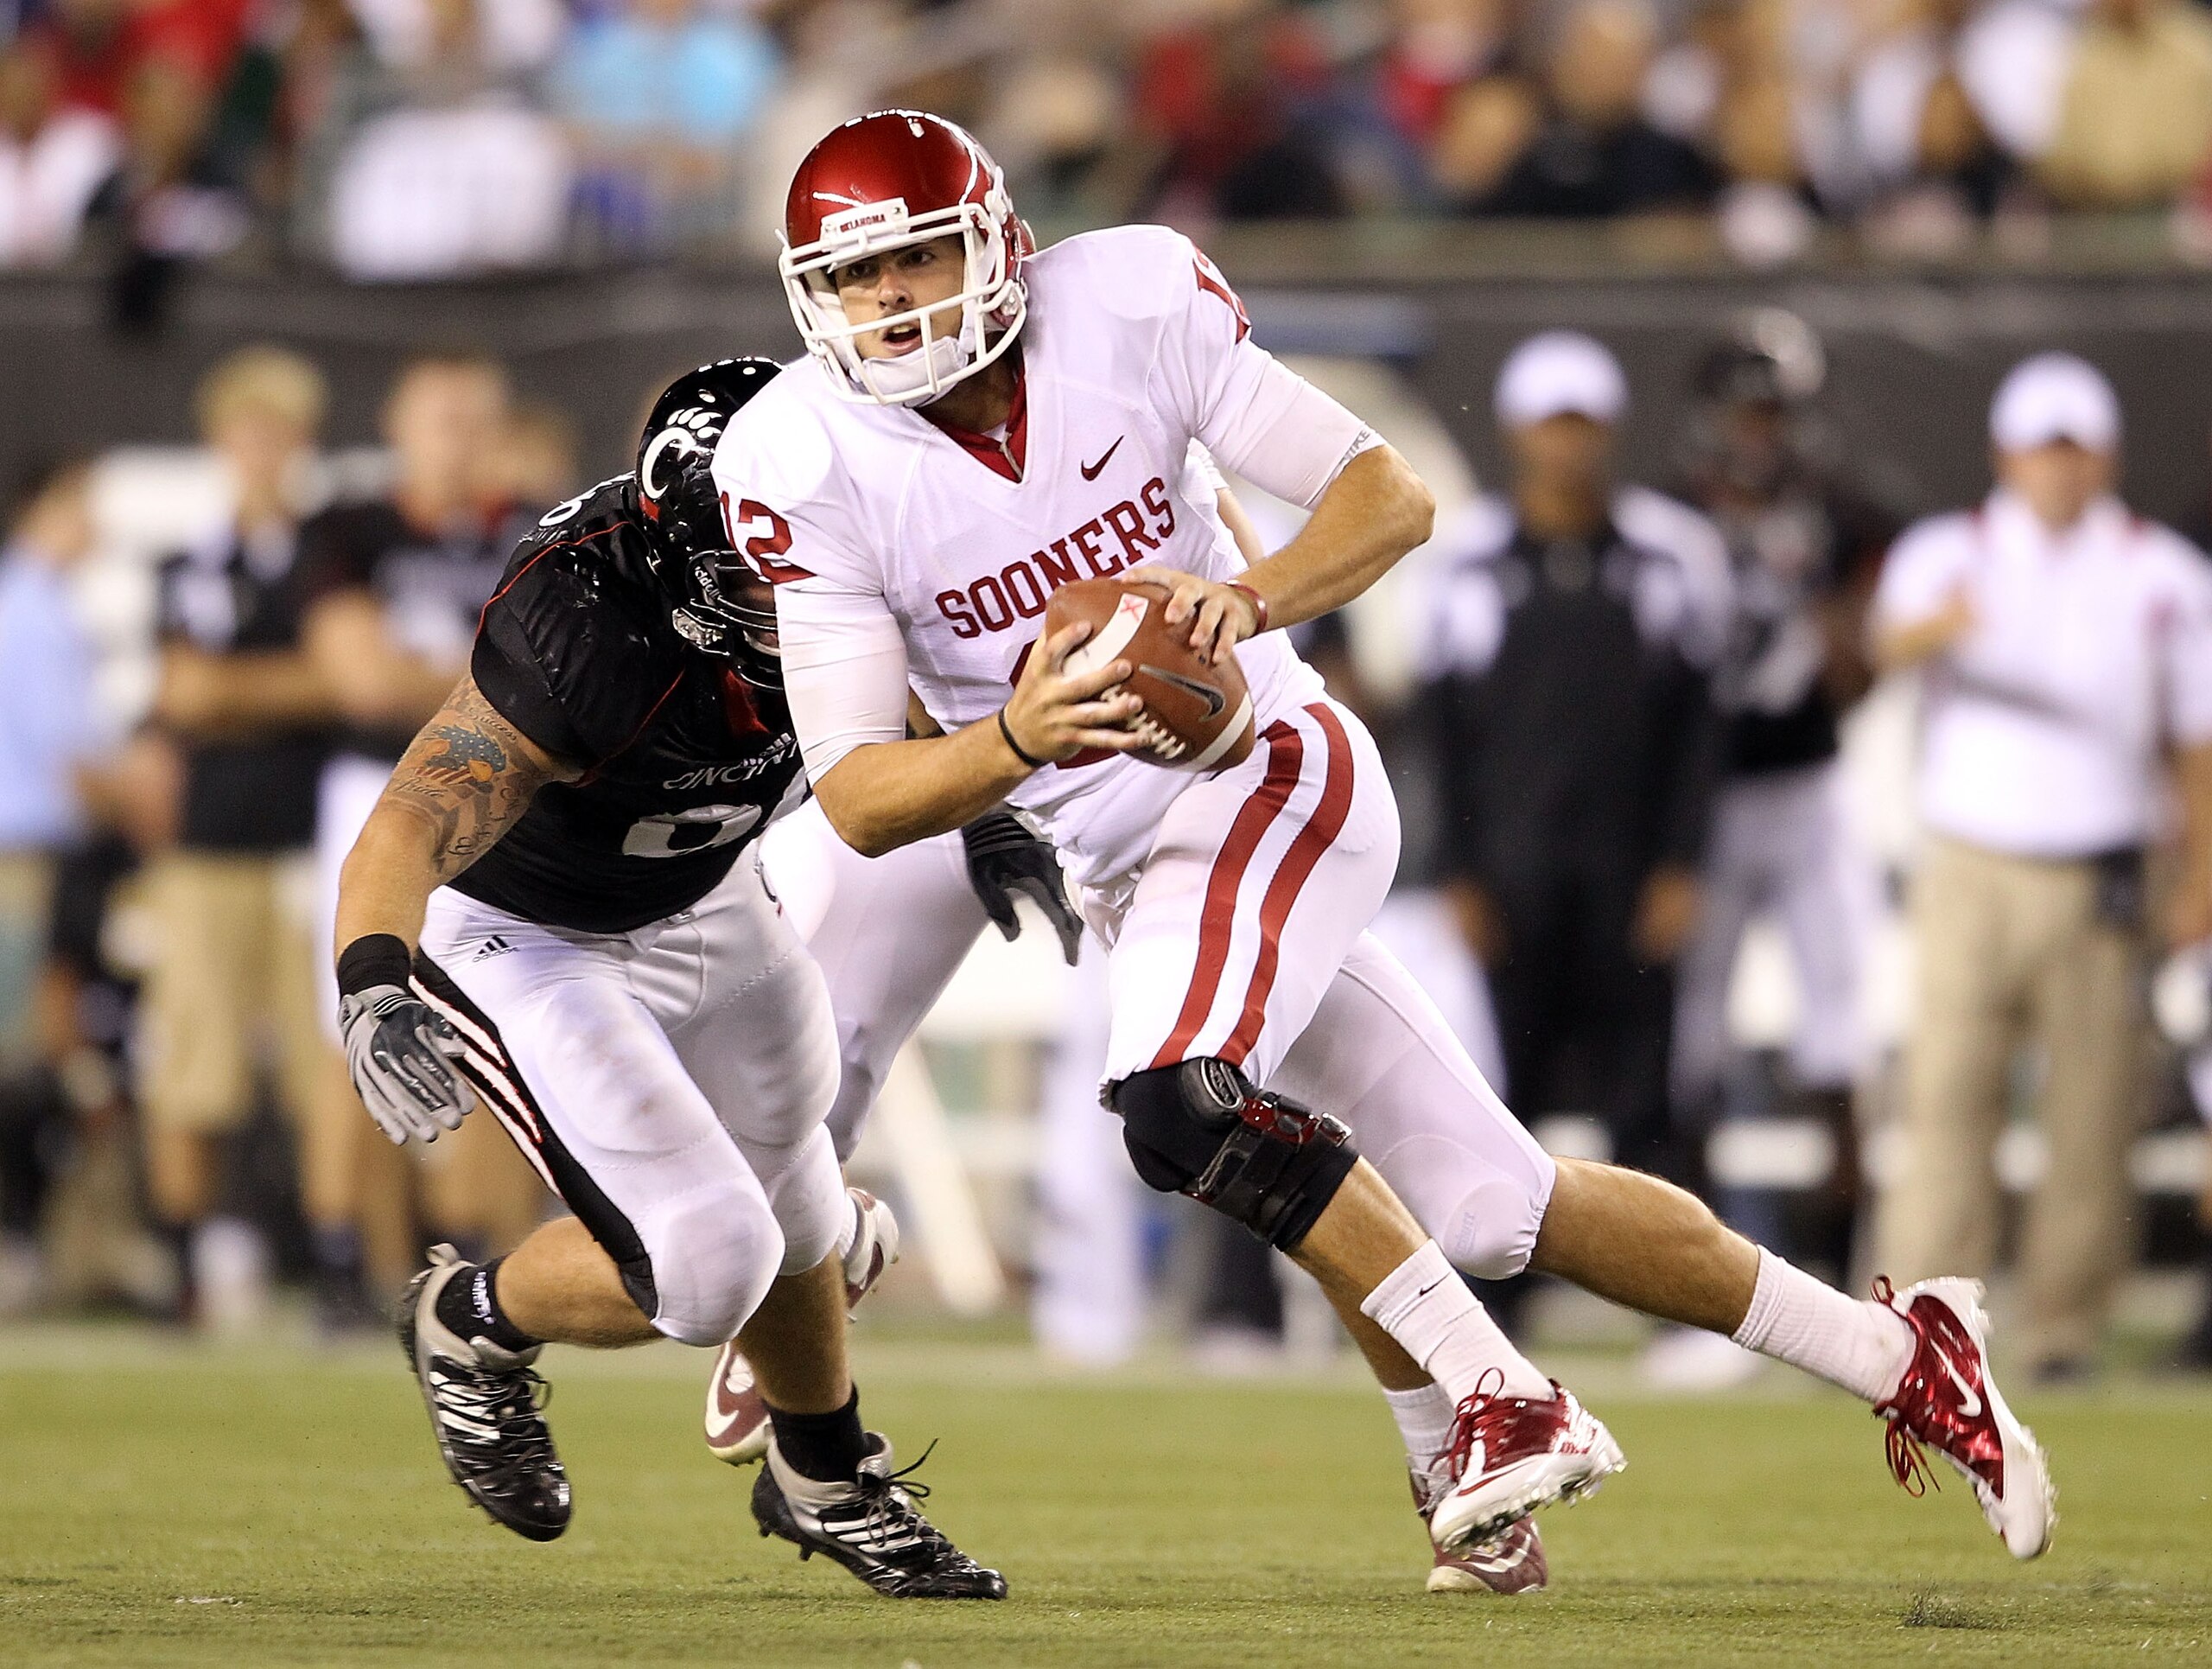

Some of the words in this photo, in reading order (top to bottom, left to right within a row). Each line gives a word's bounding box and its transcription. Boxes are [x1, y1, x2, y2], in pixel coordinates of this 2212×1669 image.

[840, 213, 887, 233] OKLAHOMA
[935, 476, 1176, 640] SOONERS
[694, 565, 721, 598] iddell
